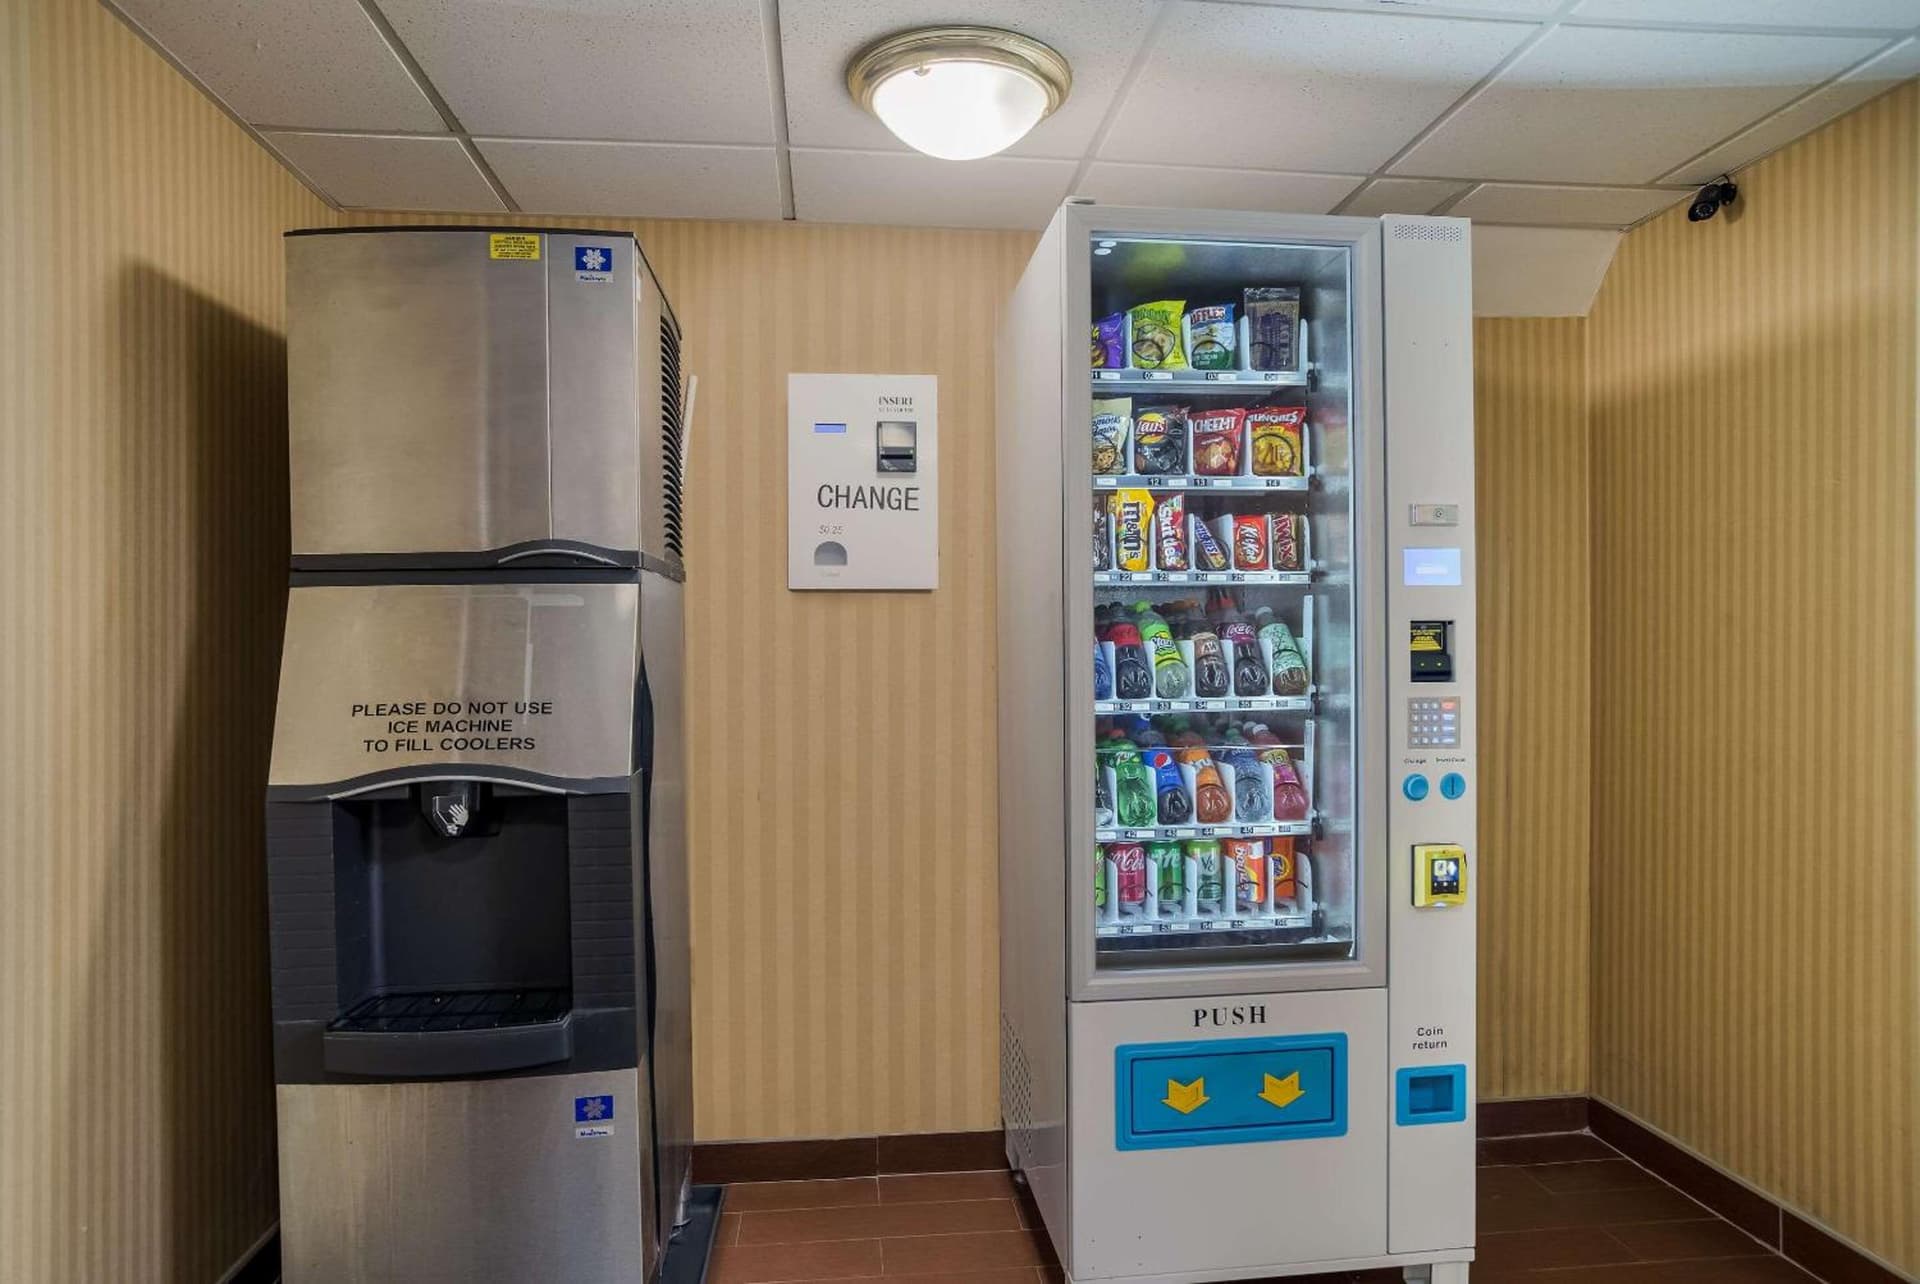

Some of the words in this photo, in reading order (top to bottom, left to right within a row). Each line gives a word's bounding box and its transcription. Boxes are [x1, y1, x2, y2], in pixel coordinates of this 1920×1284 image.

[878, 396, 914, 406] INSERT
[1149, 478, 1162, 487] 12
[817, 484, 920, 511] CHANGE
[352, 702, 426, 717] PLEASE
[432, 702, 462, 716] DO
[468, 702, 509, 716] NOT
[514, 702, 553, 715] USE
[388, 720, 419, 734] ICE
[424, 720, 513, 733] MACHINE
[363, 739, 389, 752] TO
[395, 739, 434, 751] FILL
[440, 737, 536, 751] COOLERS
[1193, 1005, 1268, 1028] PUSH
[1416, 1027, 1444, 1037] Coin
[1411, 1041, 1448, 1050] return
